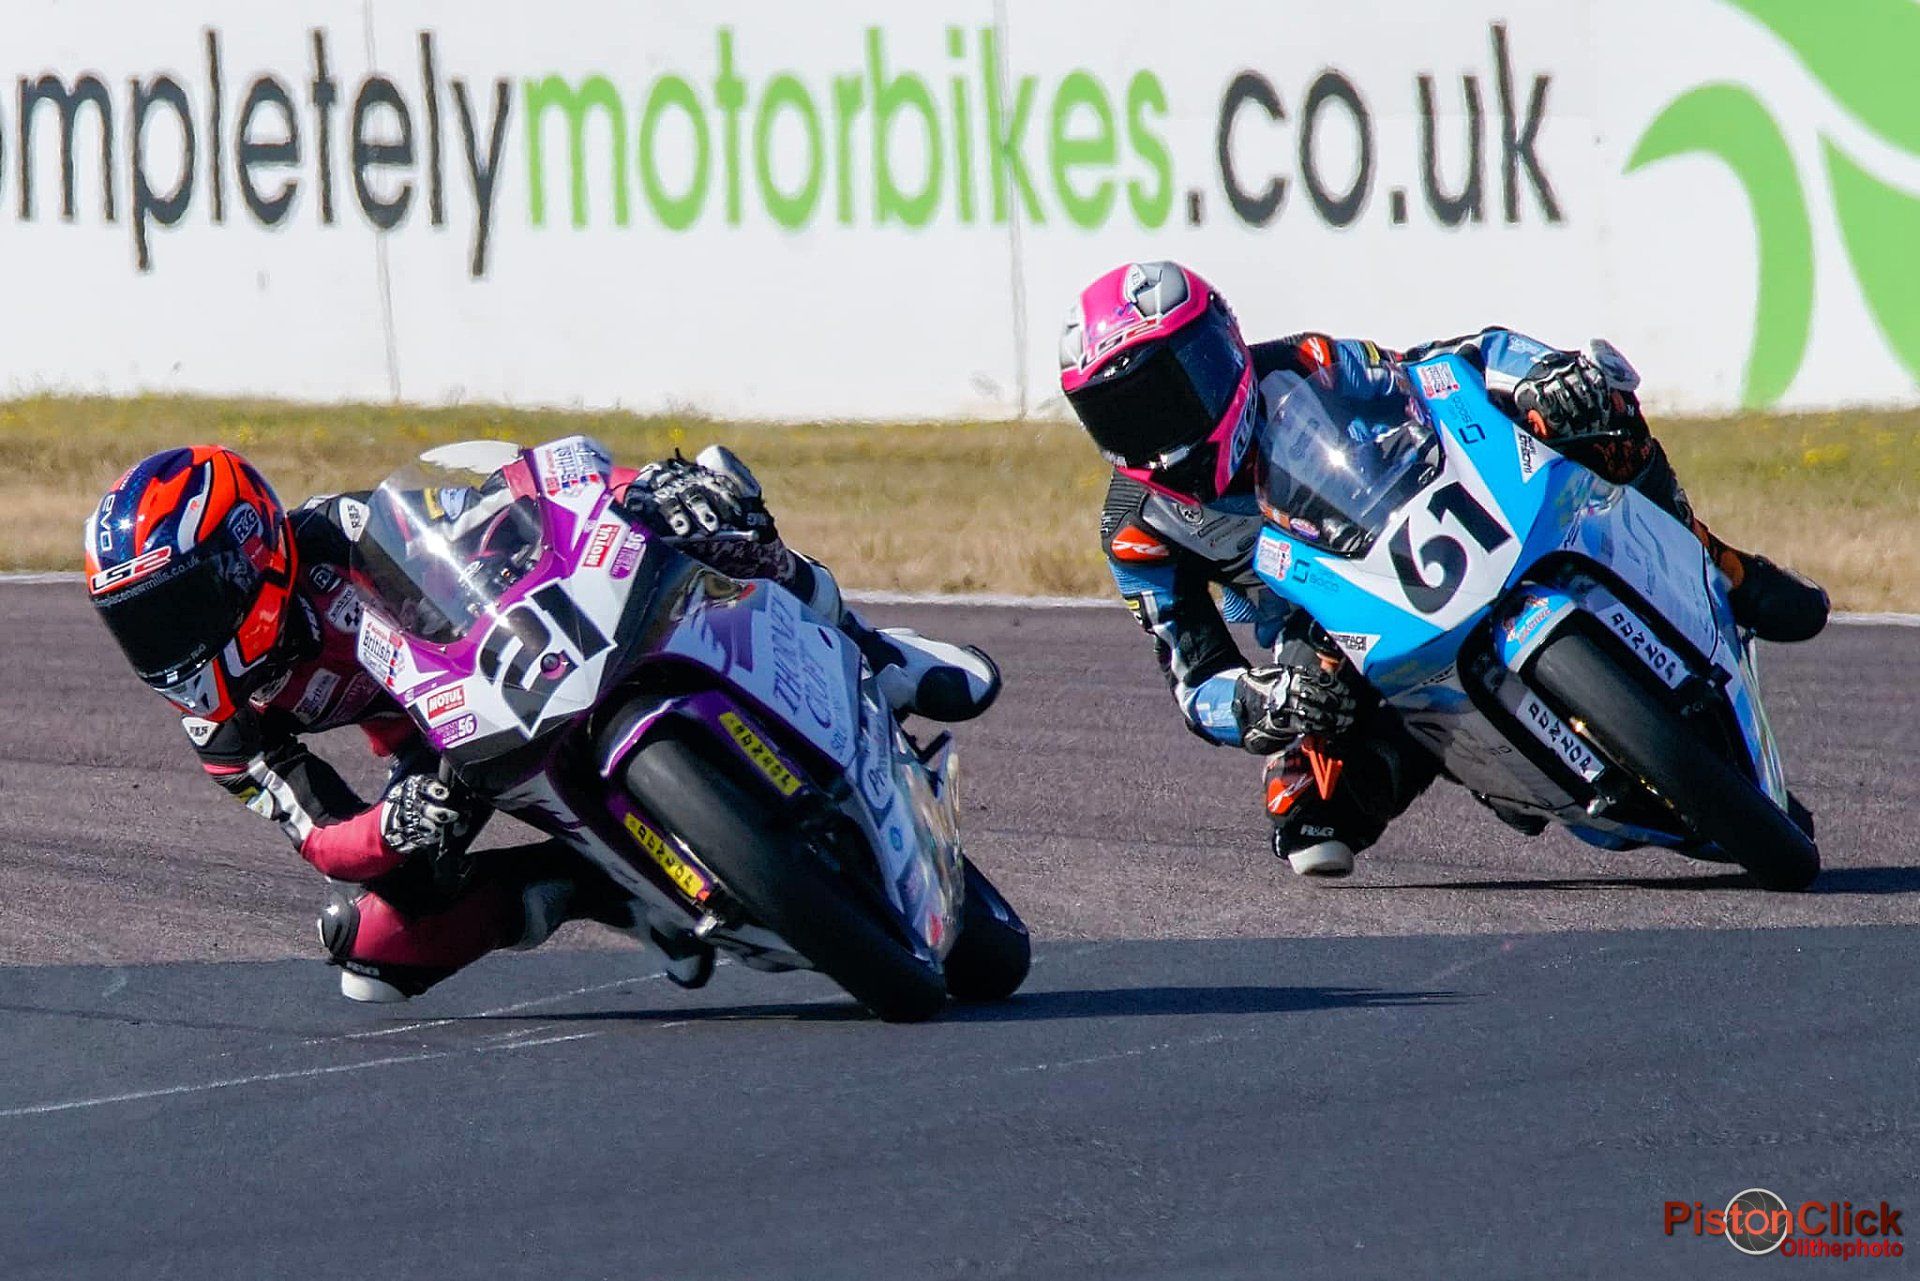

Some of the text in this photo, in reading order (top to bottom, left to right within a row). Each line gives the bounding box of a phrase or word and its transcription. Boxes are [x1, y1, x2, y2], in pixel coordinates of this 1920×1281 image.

[100, 493, 116, 551] EVO
[585, 526, 614, 567] MOTUL
[623, 530, 646, 552] 56
[91, 545, 172, 594] LS2
[1387, 481, 1513, 614] 61
[362, 628, 392, 658] British
[480, 582, 613, 734] 21
[1611, 612, 1675, 681] DUNLOP
[428, 689, 466, 716] MOTUL
[457, 714, 475, 738] 56
[1528, 703, 1594, 774] DUNLOP
